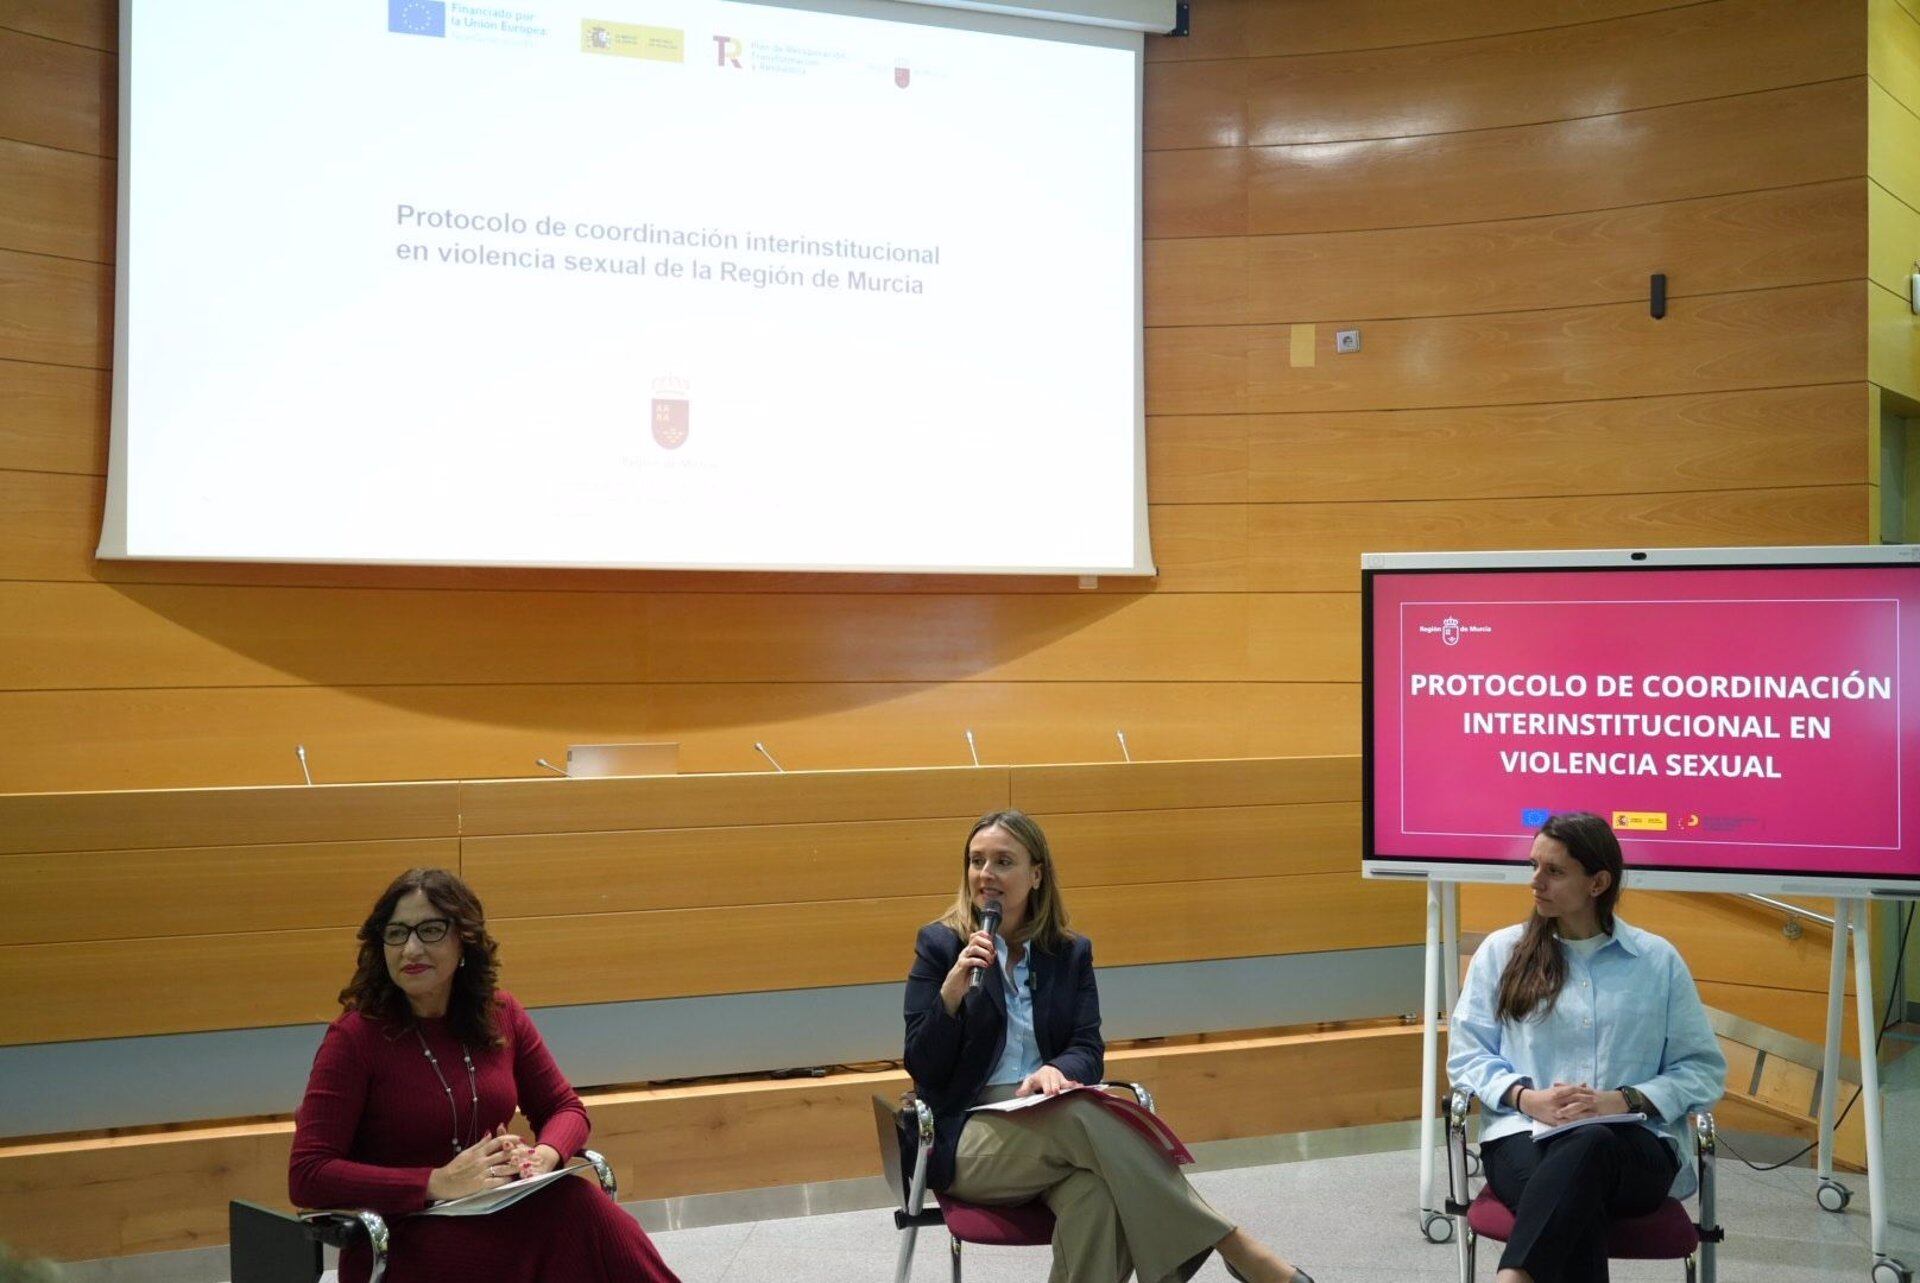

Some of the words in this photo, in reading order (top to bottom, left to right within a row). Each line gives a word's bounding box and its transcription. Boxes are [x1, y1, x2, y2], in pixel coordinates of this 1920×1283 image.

[398, 205, 526, 233] Protocolo
[536, 216, 566, 236] de
[575, 224, 737, 248] coordinación
[746, 231, 940, 265] interinstitucional
[397, 244, 428, 261] en
[438, 243, 554, 269] violencia
[565, 256, 645, 274] sexual
[655, 258, 683, 277] de
[693, 260, 711, 279] la
[721, 262, 803, 288] Región
[813, 269, 839, 288] de
[849, 271, 922, 294] Murcia
[1420, 625, 1441, 633] Región
[1411, 675, 1587, 696] PROTOCOLO
[1597, 676, 1633, 697] DE
[1643, 671, 1890, 699] COORDINACIÓN
[1464, 713, 1780, 738] INTERINSTITUCIONAL
[1791, 716, 1830, 738] EN
[1501, 751, 1658, 775] VIOLENCIA
[1666, 754, 1781, 778] SEXUAL
